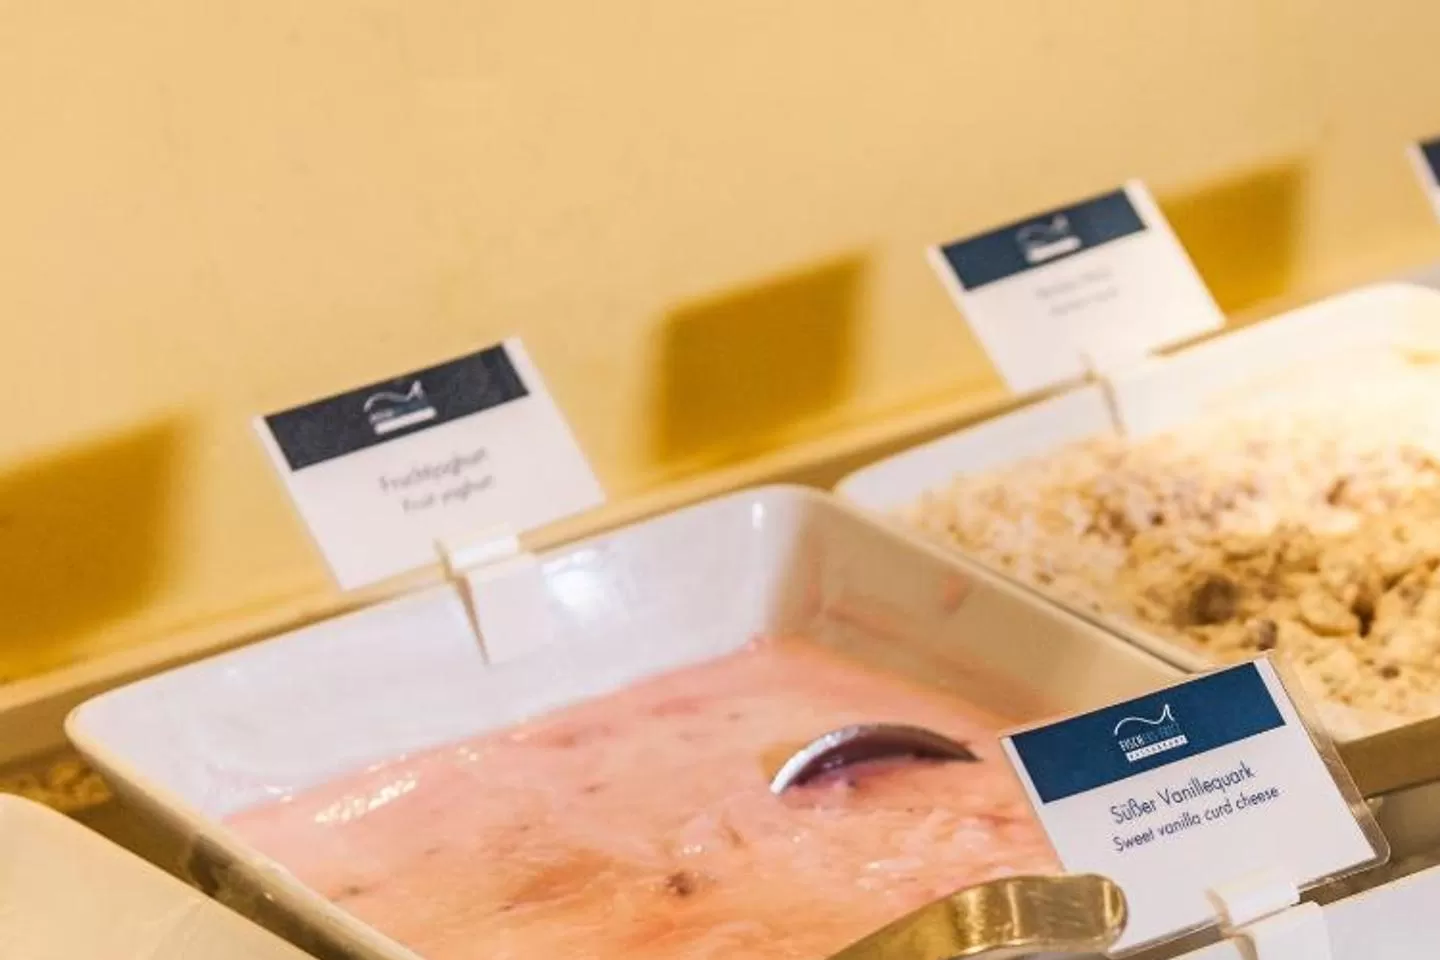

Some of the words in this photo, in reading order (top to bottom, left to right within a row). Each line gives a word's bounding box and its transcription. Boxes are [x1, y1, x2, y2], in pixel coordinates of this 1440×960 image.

[1109, 797, 1158, 825] Süßer
[1157, 760, 1255, 807] Vanillequark
[1112, 826, 1155, 853] Sweet
[1157, 811, 1201, 837] vanilla
[1203, 797, 1235, 822] curd
[1235, 786, 1281, 811] cheese
